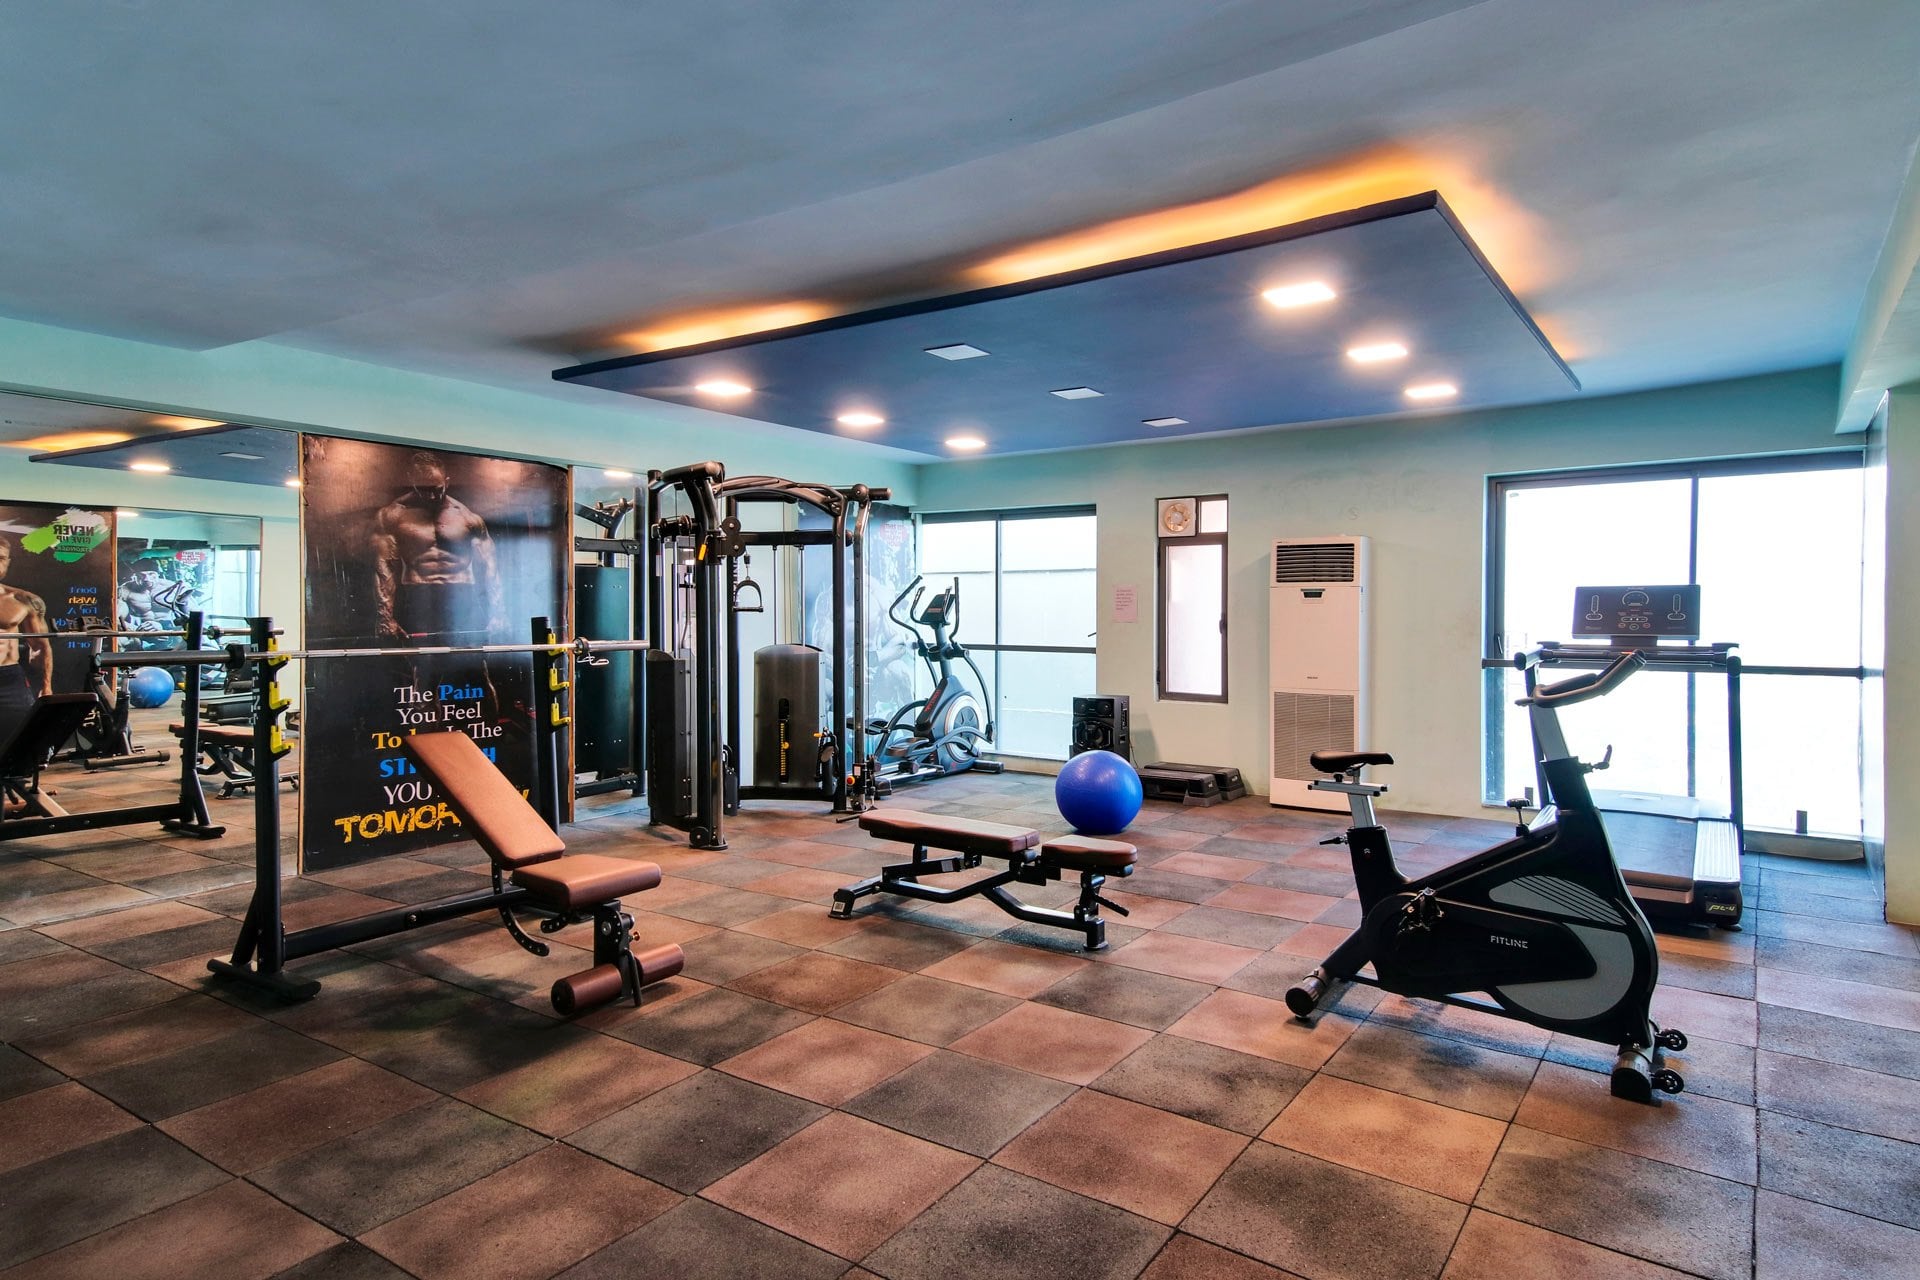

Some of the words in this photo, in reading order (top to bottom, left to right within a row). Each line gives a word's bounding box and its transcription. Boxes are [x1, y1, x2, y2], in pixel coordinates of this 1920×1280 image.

[393, 685, 433, 704] The
[438, 683, 484, 701] Pain
[395, 707, 437, 725] You
[442, 701, 482, 721] Feel
[467, 721, 503, 740] The
[383, 781, 433, 805] YOU
[1490, 935, 1529, 949] FITLINE
